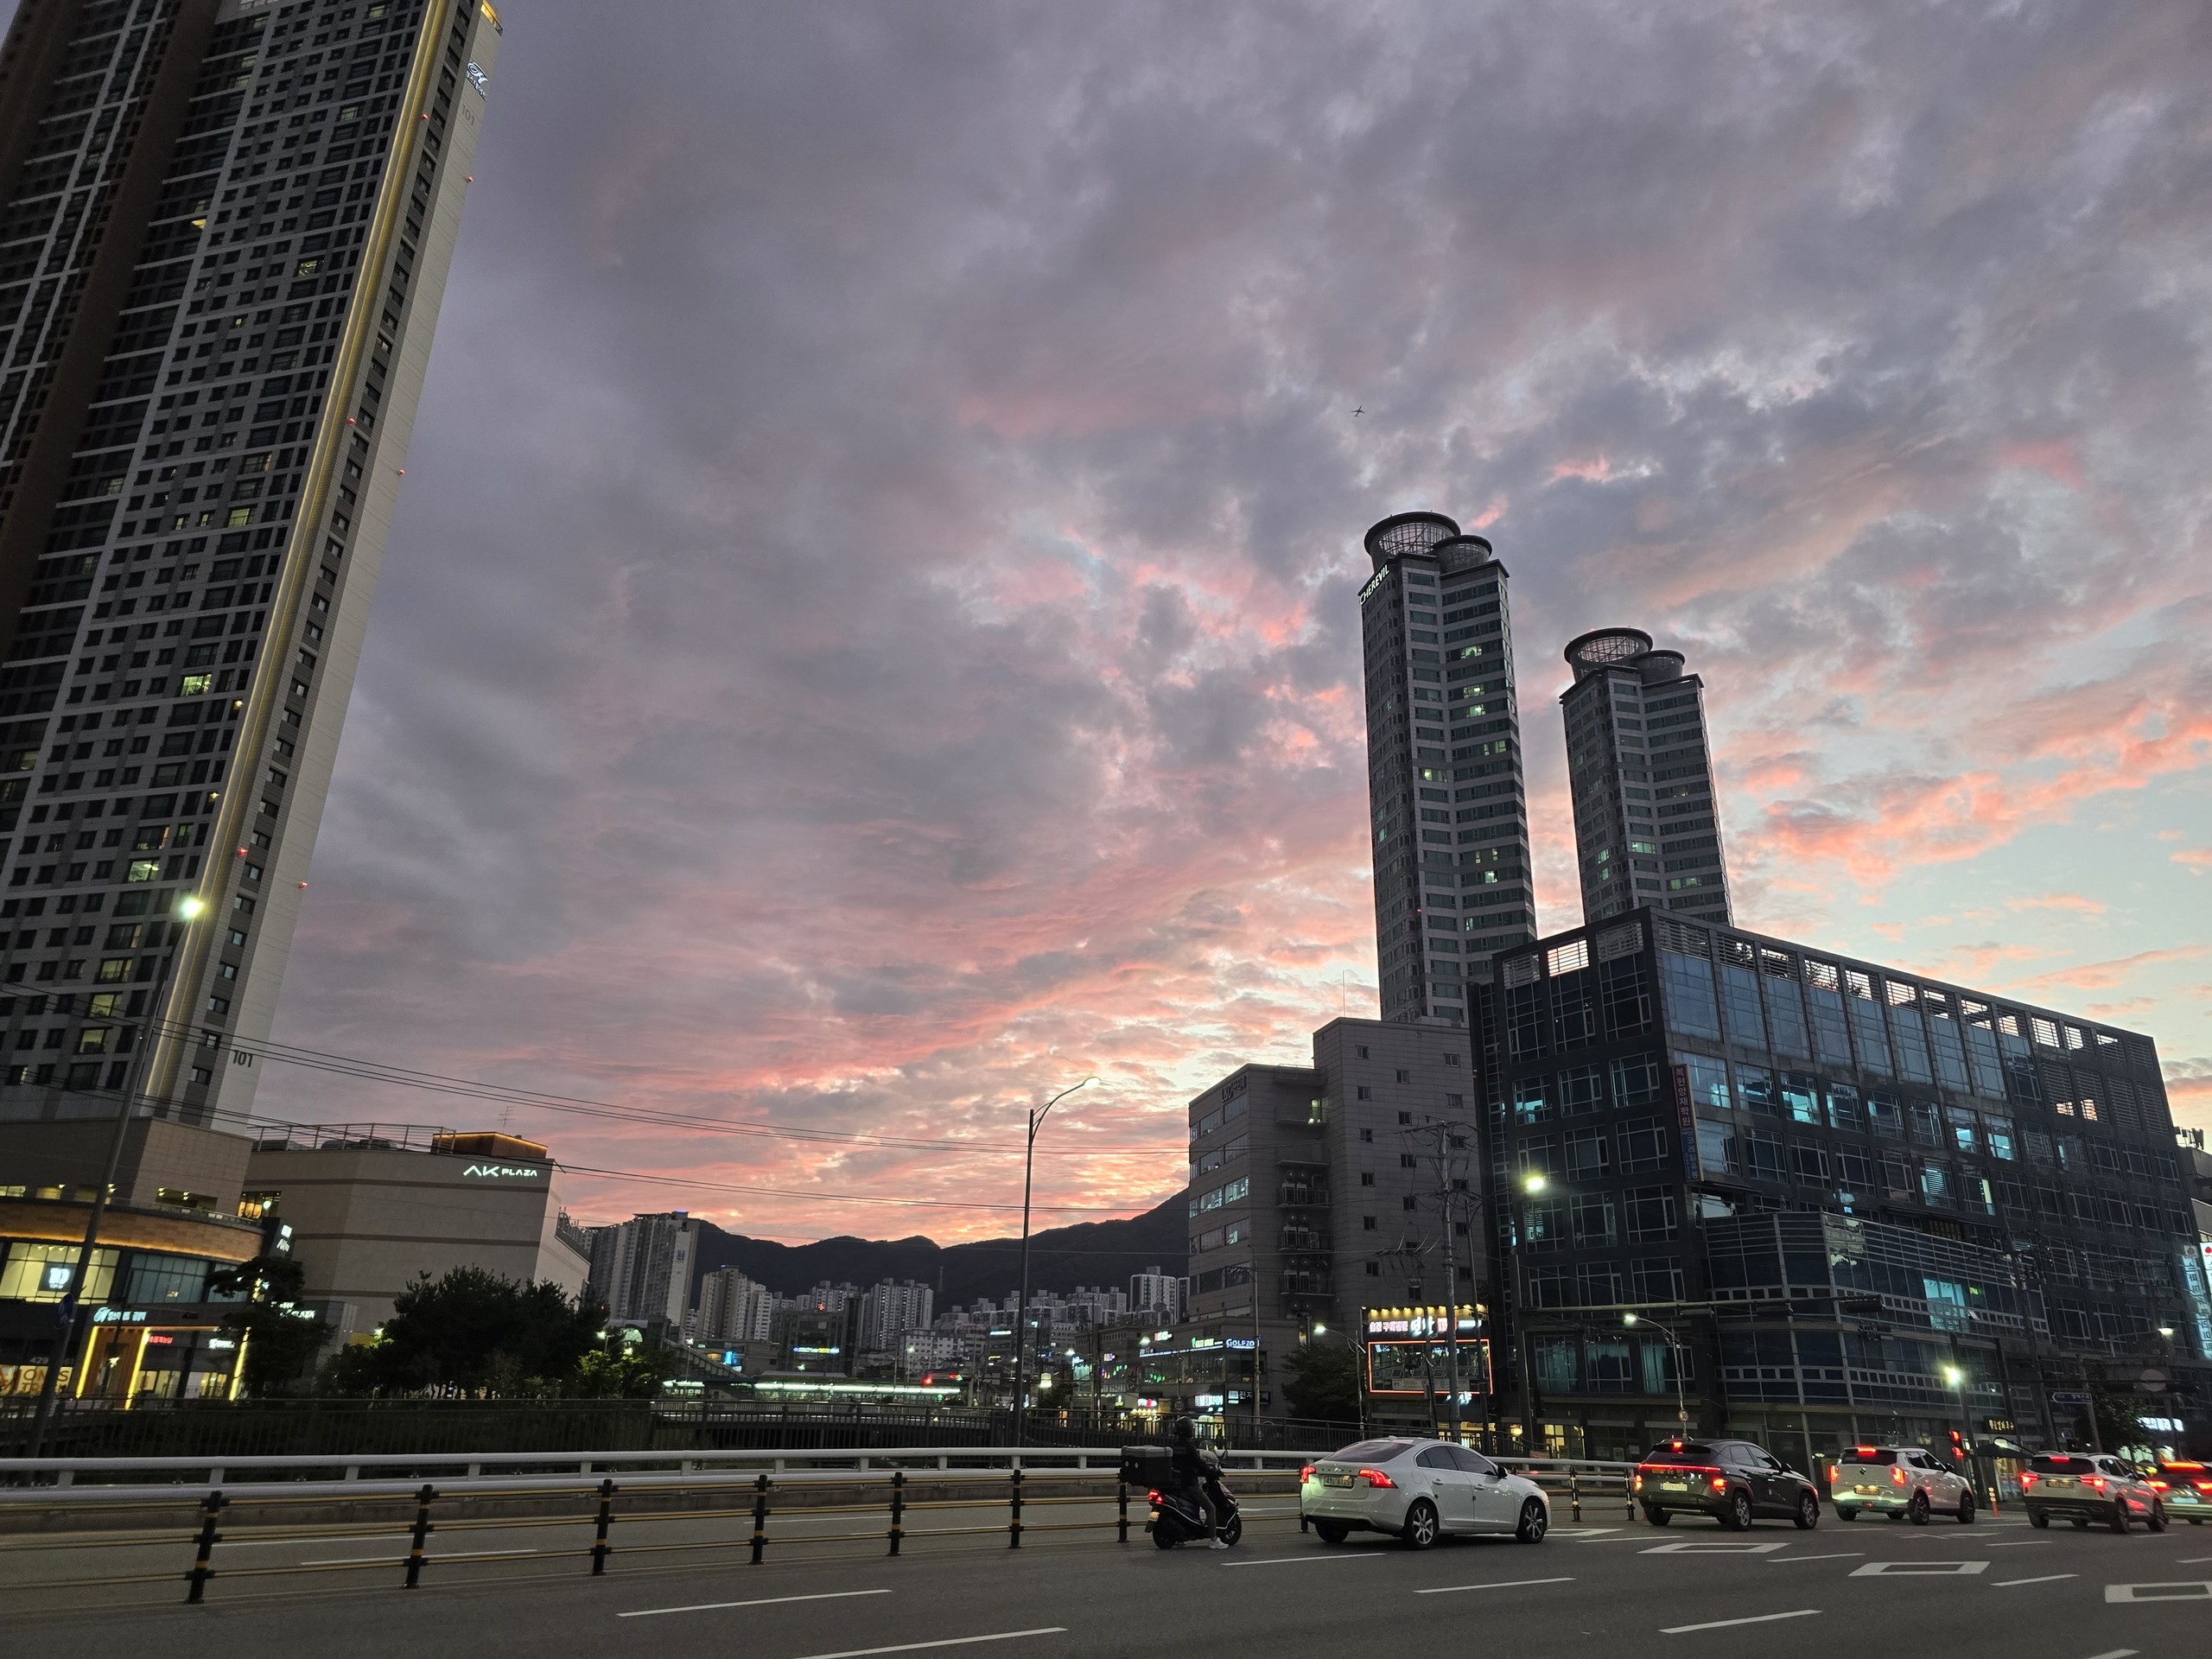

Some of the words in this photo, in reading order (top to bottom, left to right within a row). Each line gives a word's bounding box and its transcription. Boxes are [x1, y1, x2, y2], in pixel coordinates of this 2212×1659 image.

[461, 104, 475, 126] 101
[1359, 564, 1389, 604] CHEREVIL
[232, 1050, 253, 1067] 101
[462, 1165, 499, 1178] AK
[501, 1167, 537, 1177] PLAZA
